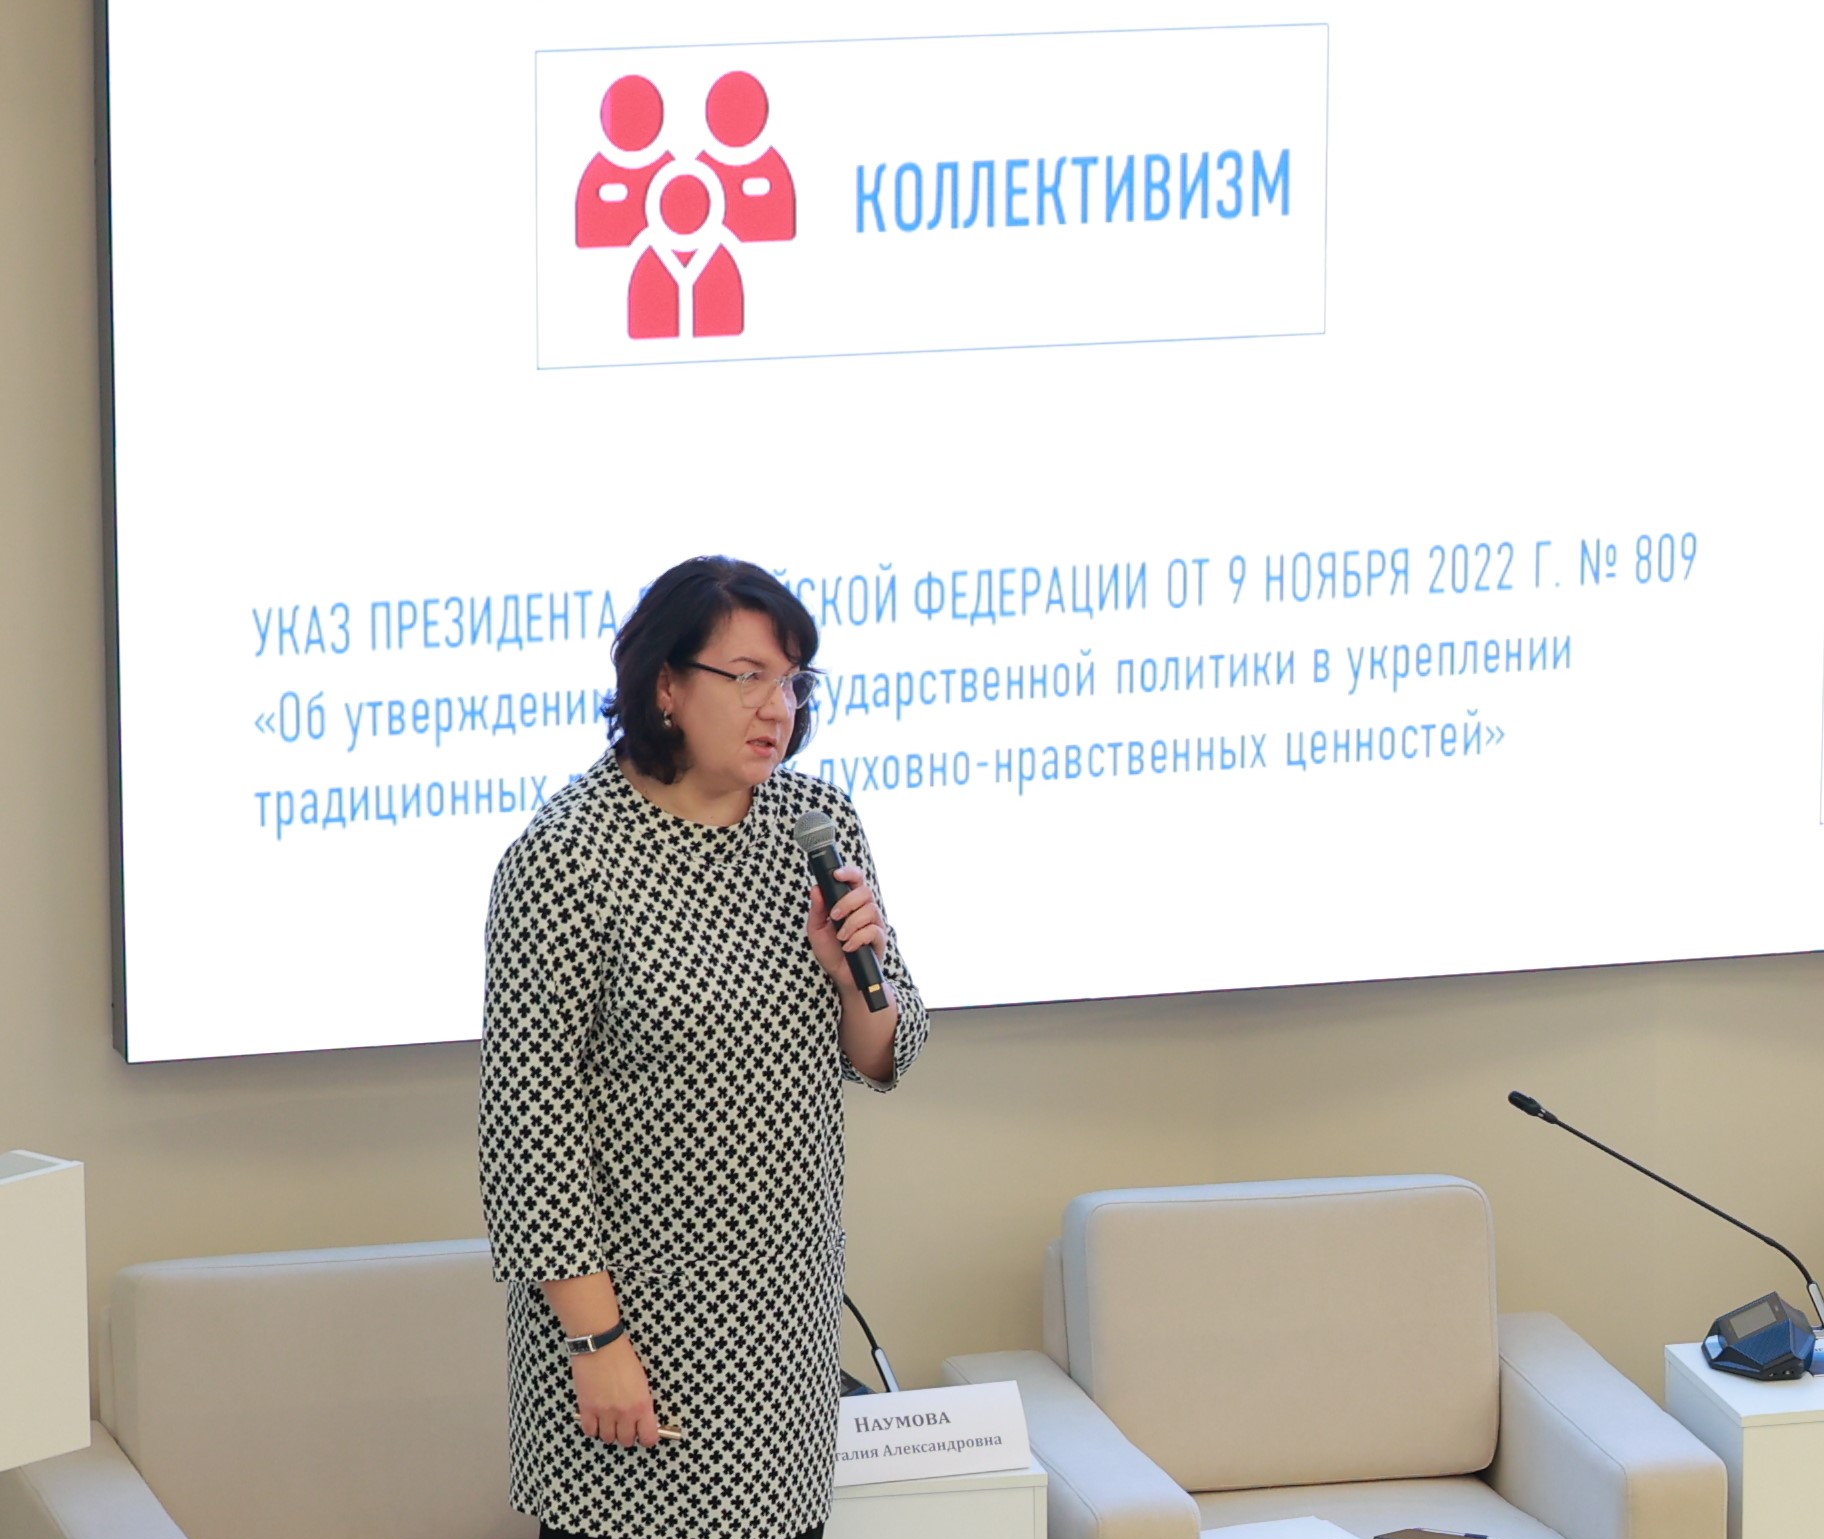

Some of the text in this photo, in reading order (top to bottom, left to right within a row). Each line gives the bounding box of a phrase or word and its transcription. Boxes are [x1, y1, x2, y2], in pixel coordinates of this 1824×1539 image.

[854, 146, 1292, 235] КОЛЛЕКТИВИЗМ
[250, 600, 353, 659] УКАЗ
[368, 587, 619, 653] ПРЕЗИДЕНТА
[912, 561, 1149, 627] ФЕДЕРАЦИИ
[1165, 556, 1213, 610] ОТ
[1226, 552, 1249, 605] 9
[1264, 546, 1412, 604] НОЯБРЯ
[1426, 539, 1517, 596] 2022
[1533, 538, 1562, 591] Г.
[1578, 537, 1619, 587] №
[1633, 529, 1700, 586] 809
[253, 689, 329, 745] «Об
[1115, 648, 1297, 697] политики
[1311, 645, 1333, 686] в
[1346, 633, 1574, 697] укреплении
[253, 707, 1507, 842] традиционных духовно-нравственных ценностей»
[853, 1410, 952, 1434] НАУМОВА
[883, 1434, 1003, 1457] Александровна
